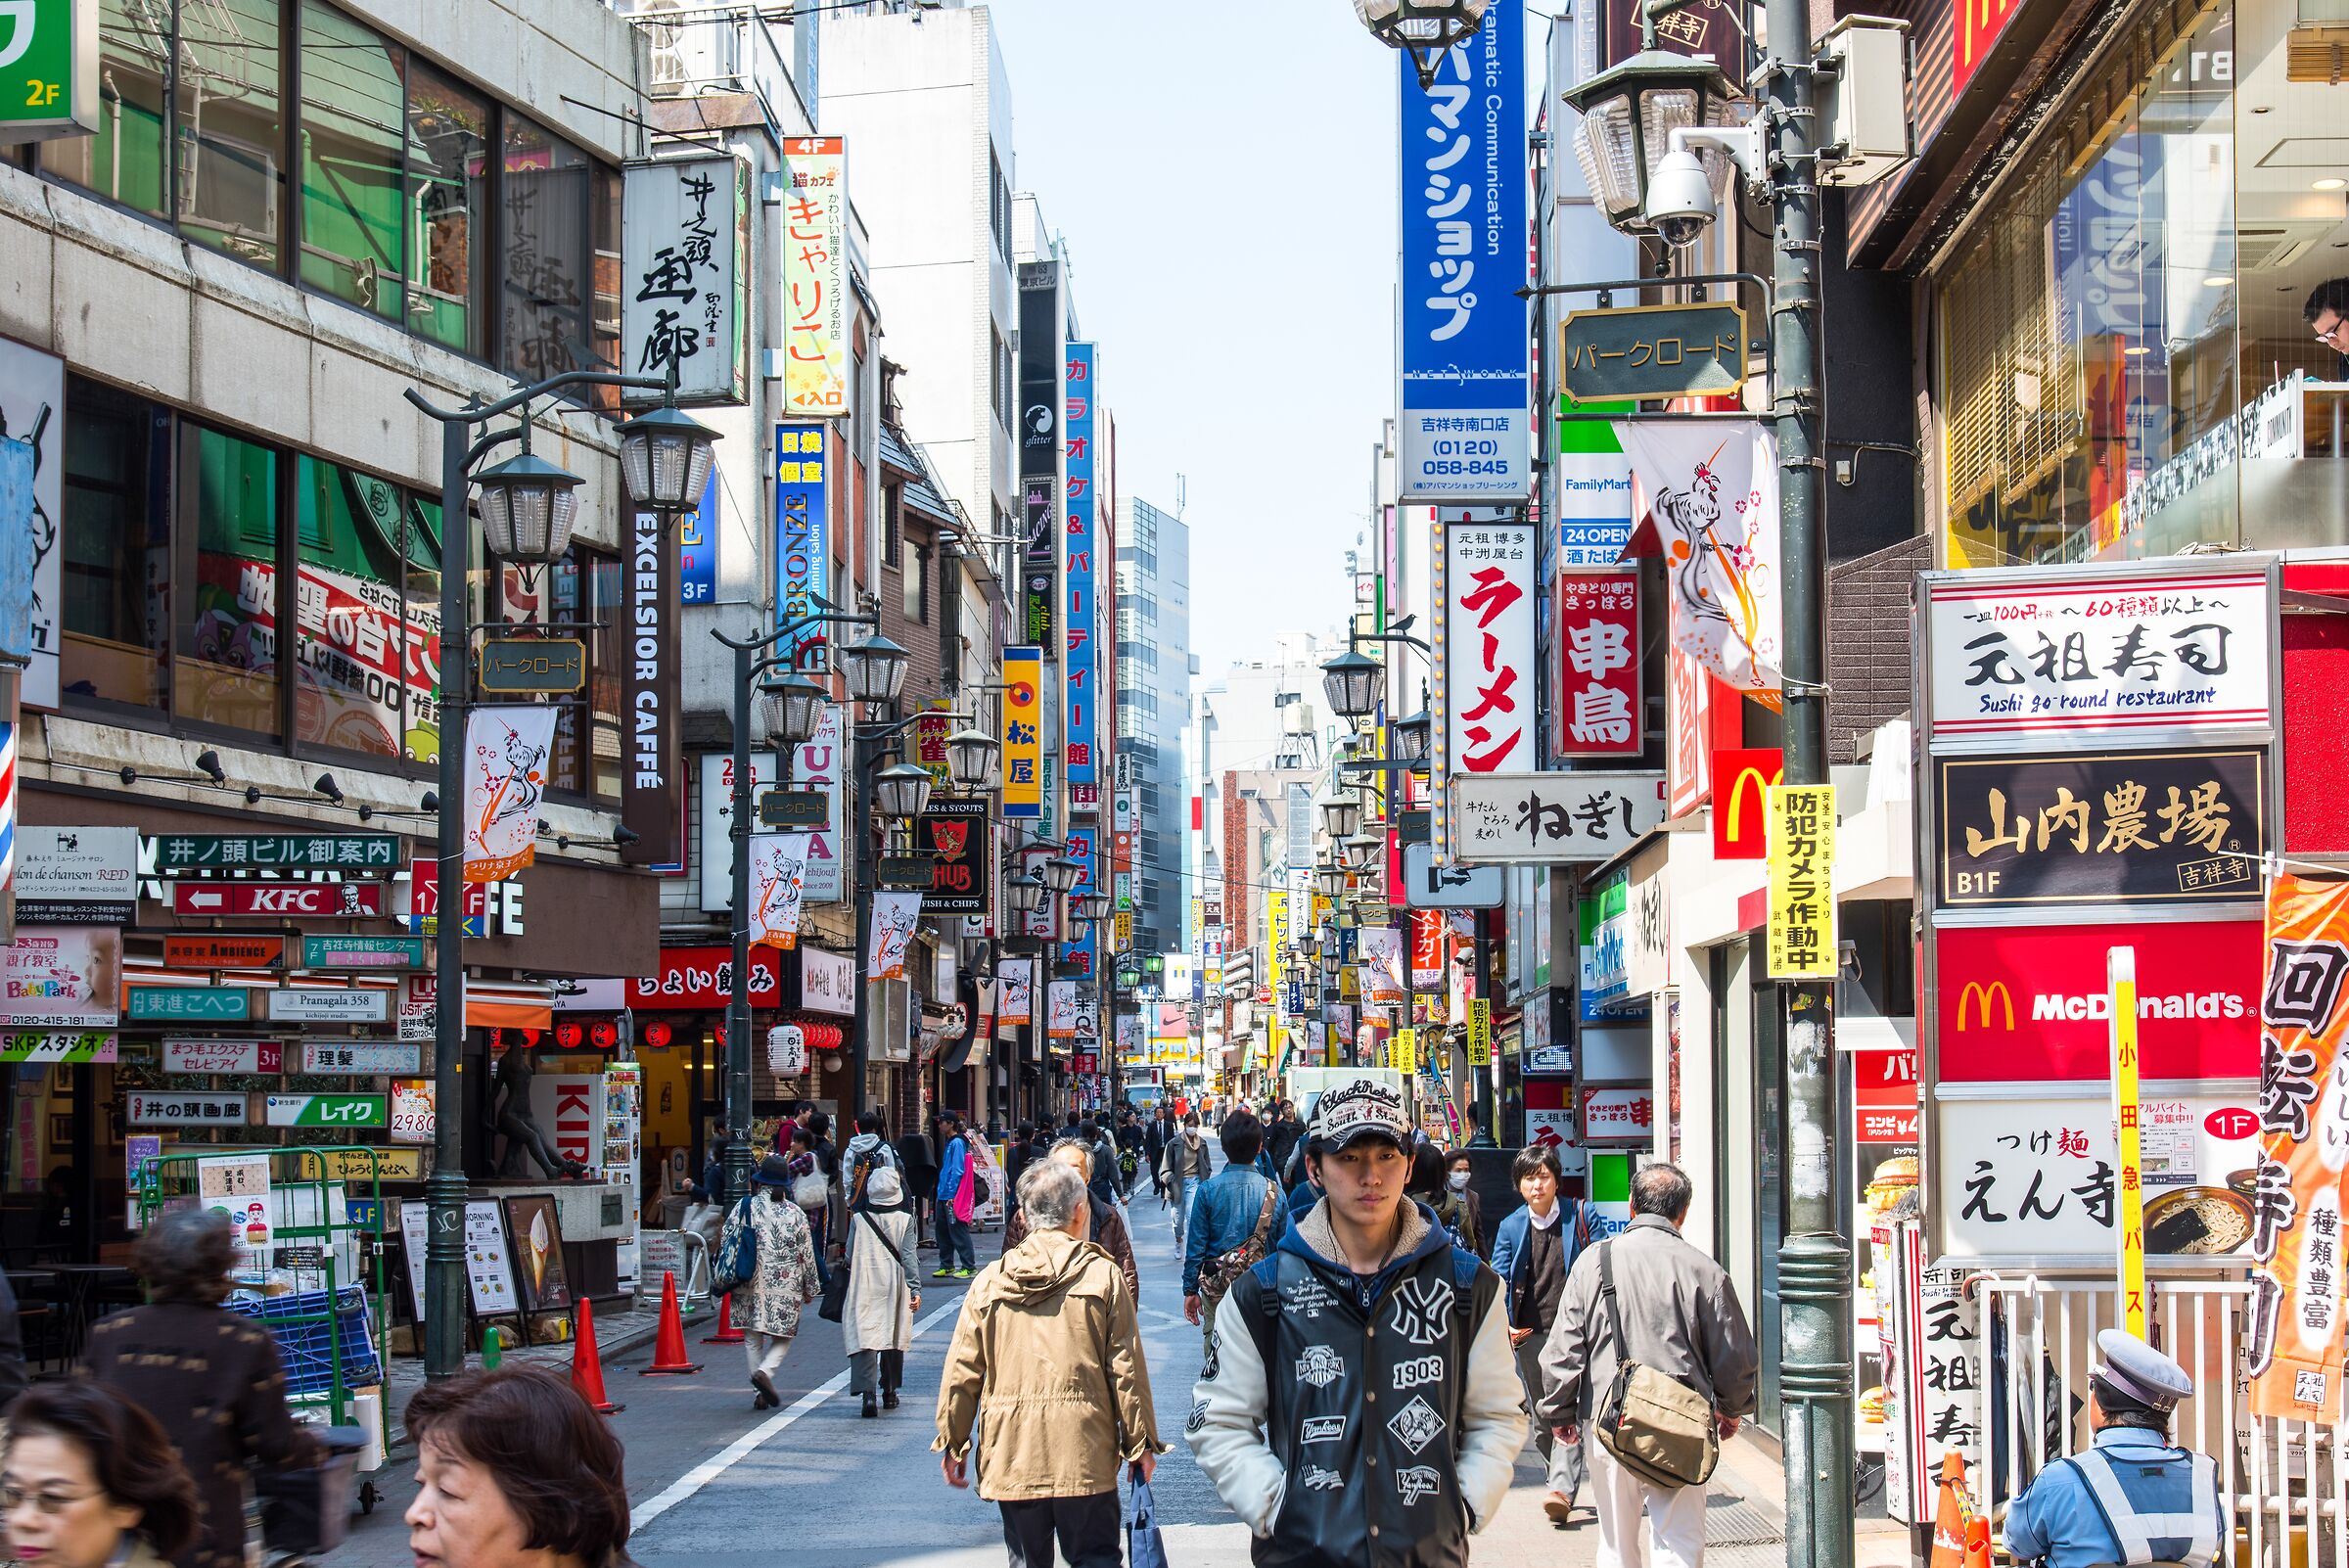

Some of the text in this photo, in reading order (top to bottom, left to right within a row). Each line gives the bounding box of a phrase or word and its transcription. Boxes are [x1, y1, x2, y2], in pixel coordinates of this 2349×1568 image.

[1654, 13, 1701, 41] 祥寺
[25, 80, 60, 106] 2F
[798, 139, 825, 154] 4F
[1485, 94, 1505, 256] Communication
[788, 197, 827, 362] きゃりこ
[1572, 333, 1738, 371] パークロード
[806, 392, 842, 406] 入口
[1421, 417, 1509, 432] 吉祥寺南口店
[782, 432, 823, 453] 日焼
[1025, 434, 1053, 448] glitter
[1432, 438, 1498, 457] (0120)
[778, 462, 823, 484] 個室
[1422, 459, 1508, 477] 058-845
[1412, 481, 1518, 491] (株)アパマンショップリーシング
[1565, 477, 1632, 493] FamilyMart
[808, 524, 821, 552] salon
[1457, 532, 1526, 545] 元祖博多
[1566, 529, 1632, 543] 24 OPEN
[785, 493, 808, 619] BRONZE
[1459, 548, 1524, 561] 中洲屋台
[1567, 549, 1584, 564] 酒
[635, 513, 658, 680] EXCELSIOR
[682, 583, 708, 598] 3F
[1565, 581, 1634, 595] やきとり専門
[1964, 623, 2233, 685] 元祖寿司
[485, 656, 578, 674] パークロード
[1461, 566, 1523, 773] ラーメン
[1568, 618, 1633, 744] 串鳥
[1979, 693, 2023, 713] Sushi
[2116, 686, 2217, 708] restaurant
[919, 708, 948, 762] 麻雀
[1005, 719, 1036, 784] 松屋
[941, 804, 984, 812] & STOUTS
[1465, 801, 1498, 813] 牛たん
[1483, 814, 1510, 826] とろろ
[1515, 790, 1642, 849] ねぎし
[1965, 780, 2232, 858] 山内農場
[1475, 828, 1502, 840] 麦めし
[169, 839, 391, 863] 井ノ頭ビル御案内
[35, 866, 129, 881] de chanson RED
[933, 864, 972, 891] HUB
[1785, 792, 1819, 970] 防犯カメラ作動中
[2183, 860, 2246, 886] 吉祥寺
[1958, 872, 2001, 894] B1F
[250, 889, 320, 910] KFC
[322, 940, 416, 950] 吉祥寺情報センター
[1773, 910, 1782, 971] 武蔵野市
[7, 955, 57, 967] 親子教室
[7, 981, 76, 997] BabyPark
[299, 994, 369, 1008] Pranagala 358
[2032, 992, 2243, 1021] McDnald's
[12, 1016, 84, 1025] 0120-415-181
[1473, 1001, 1485, 1063] 防犯カメラ作動中
[3, 1036, 115, 1053] SKPスタジオ 6F
[171, 1043, 250, 1056] まつ毛エクステ
[259, 1050, 281, 1066] 3F
[306, 1045, 315, 1069] 3F
[318, 1050, 353, 1066] 理髪
[133, 1097, 142, 1121] 3F
[146, 1101, 242, 1119] 井の頭画廊
[321, 1102, 372, 1121] レイク
[1327, 1112, 1359, 1132] South
[1375, 1110, 1404, 1127] State
[1865, 1116, 1897, 1129] コンビ
[2154, 1114, 2193, 1124] 募集中!!
[2215, 1116, 2251, 1135] 1F
[1997, 1127, 2092, 1159] つけ麺
[2117, 1041, 2143, 1314] 小田急バス
[1961, 1160, 2115, 1228] えん寺
[465, 1213, 494, 1222] MORNING
[2302, 1206, 2338, 1330] 種類豊富
[1921, 1288, 1941, 1298] Sushi
[1394, 1358, 1444, 1387] 1903
[1304, 1419, 1342, 1437] Yankees
